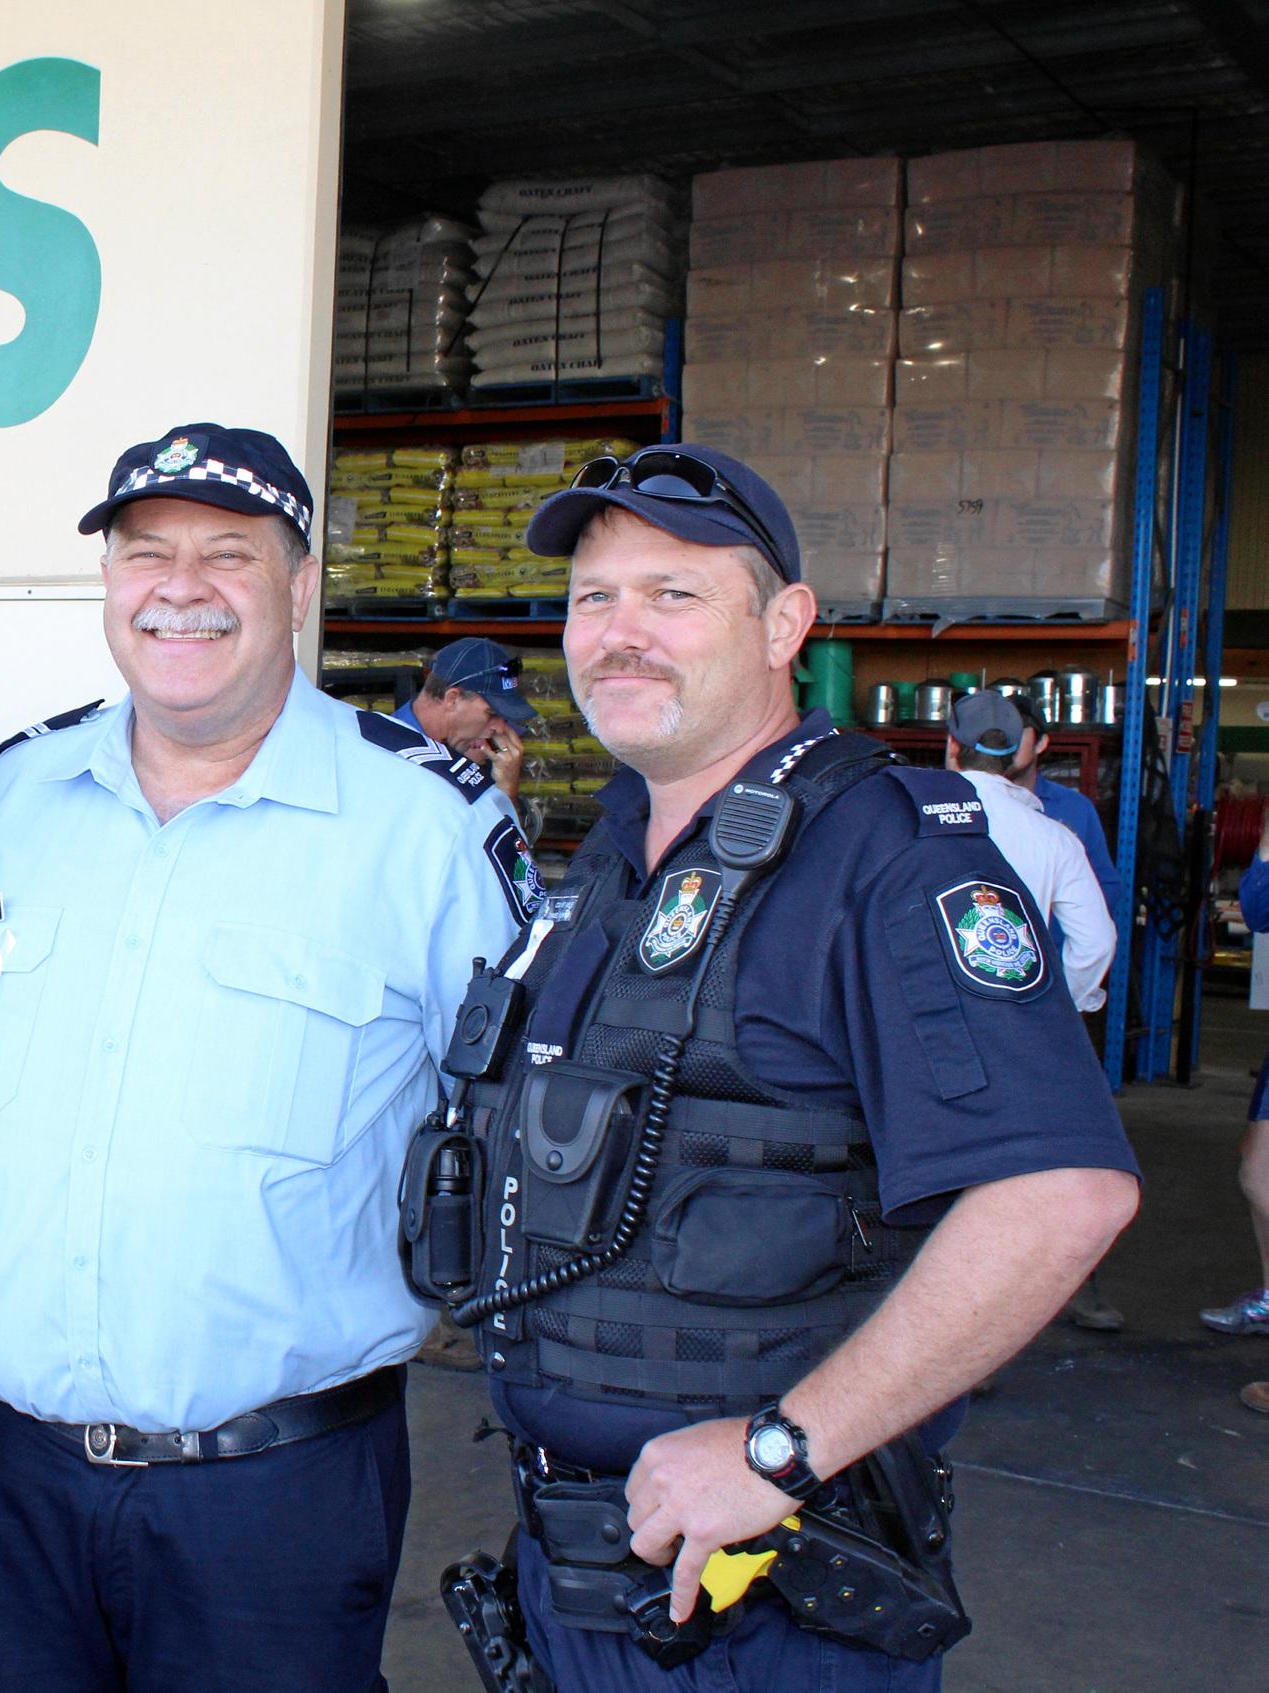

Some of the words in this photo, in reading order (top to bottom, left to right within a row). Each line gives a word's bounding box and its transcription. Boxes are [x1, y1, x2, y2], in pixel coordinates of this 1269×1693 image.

[744, 788, 780, 799] MOTOROLA
[922, 801, 982, 815] QUEENSLAND
[938, 813, 973, 824] POLICE
[976, 917, 1018, 941] QUEENSLAND
[989, 944, 1018, 957] POLICE
